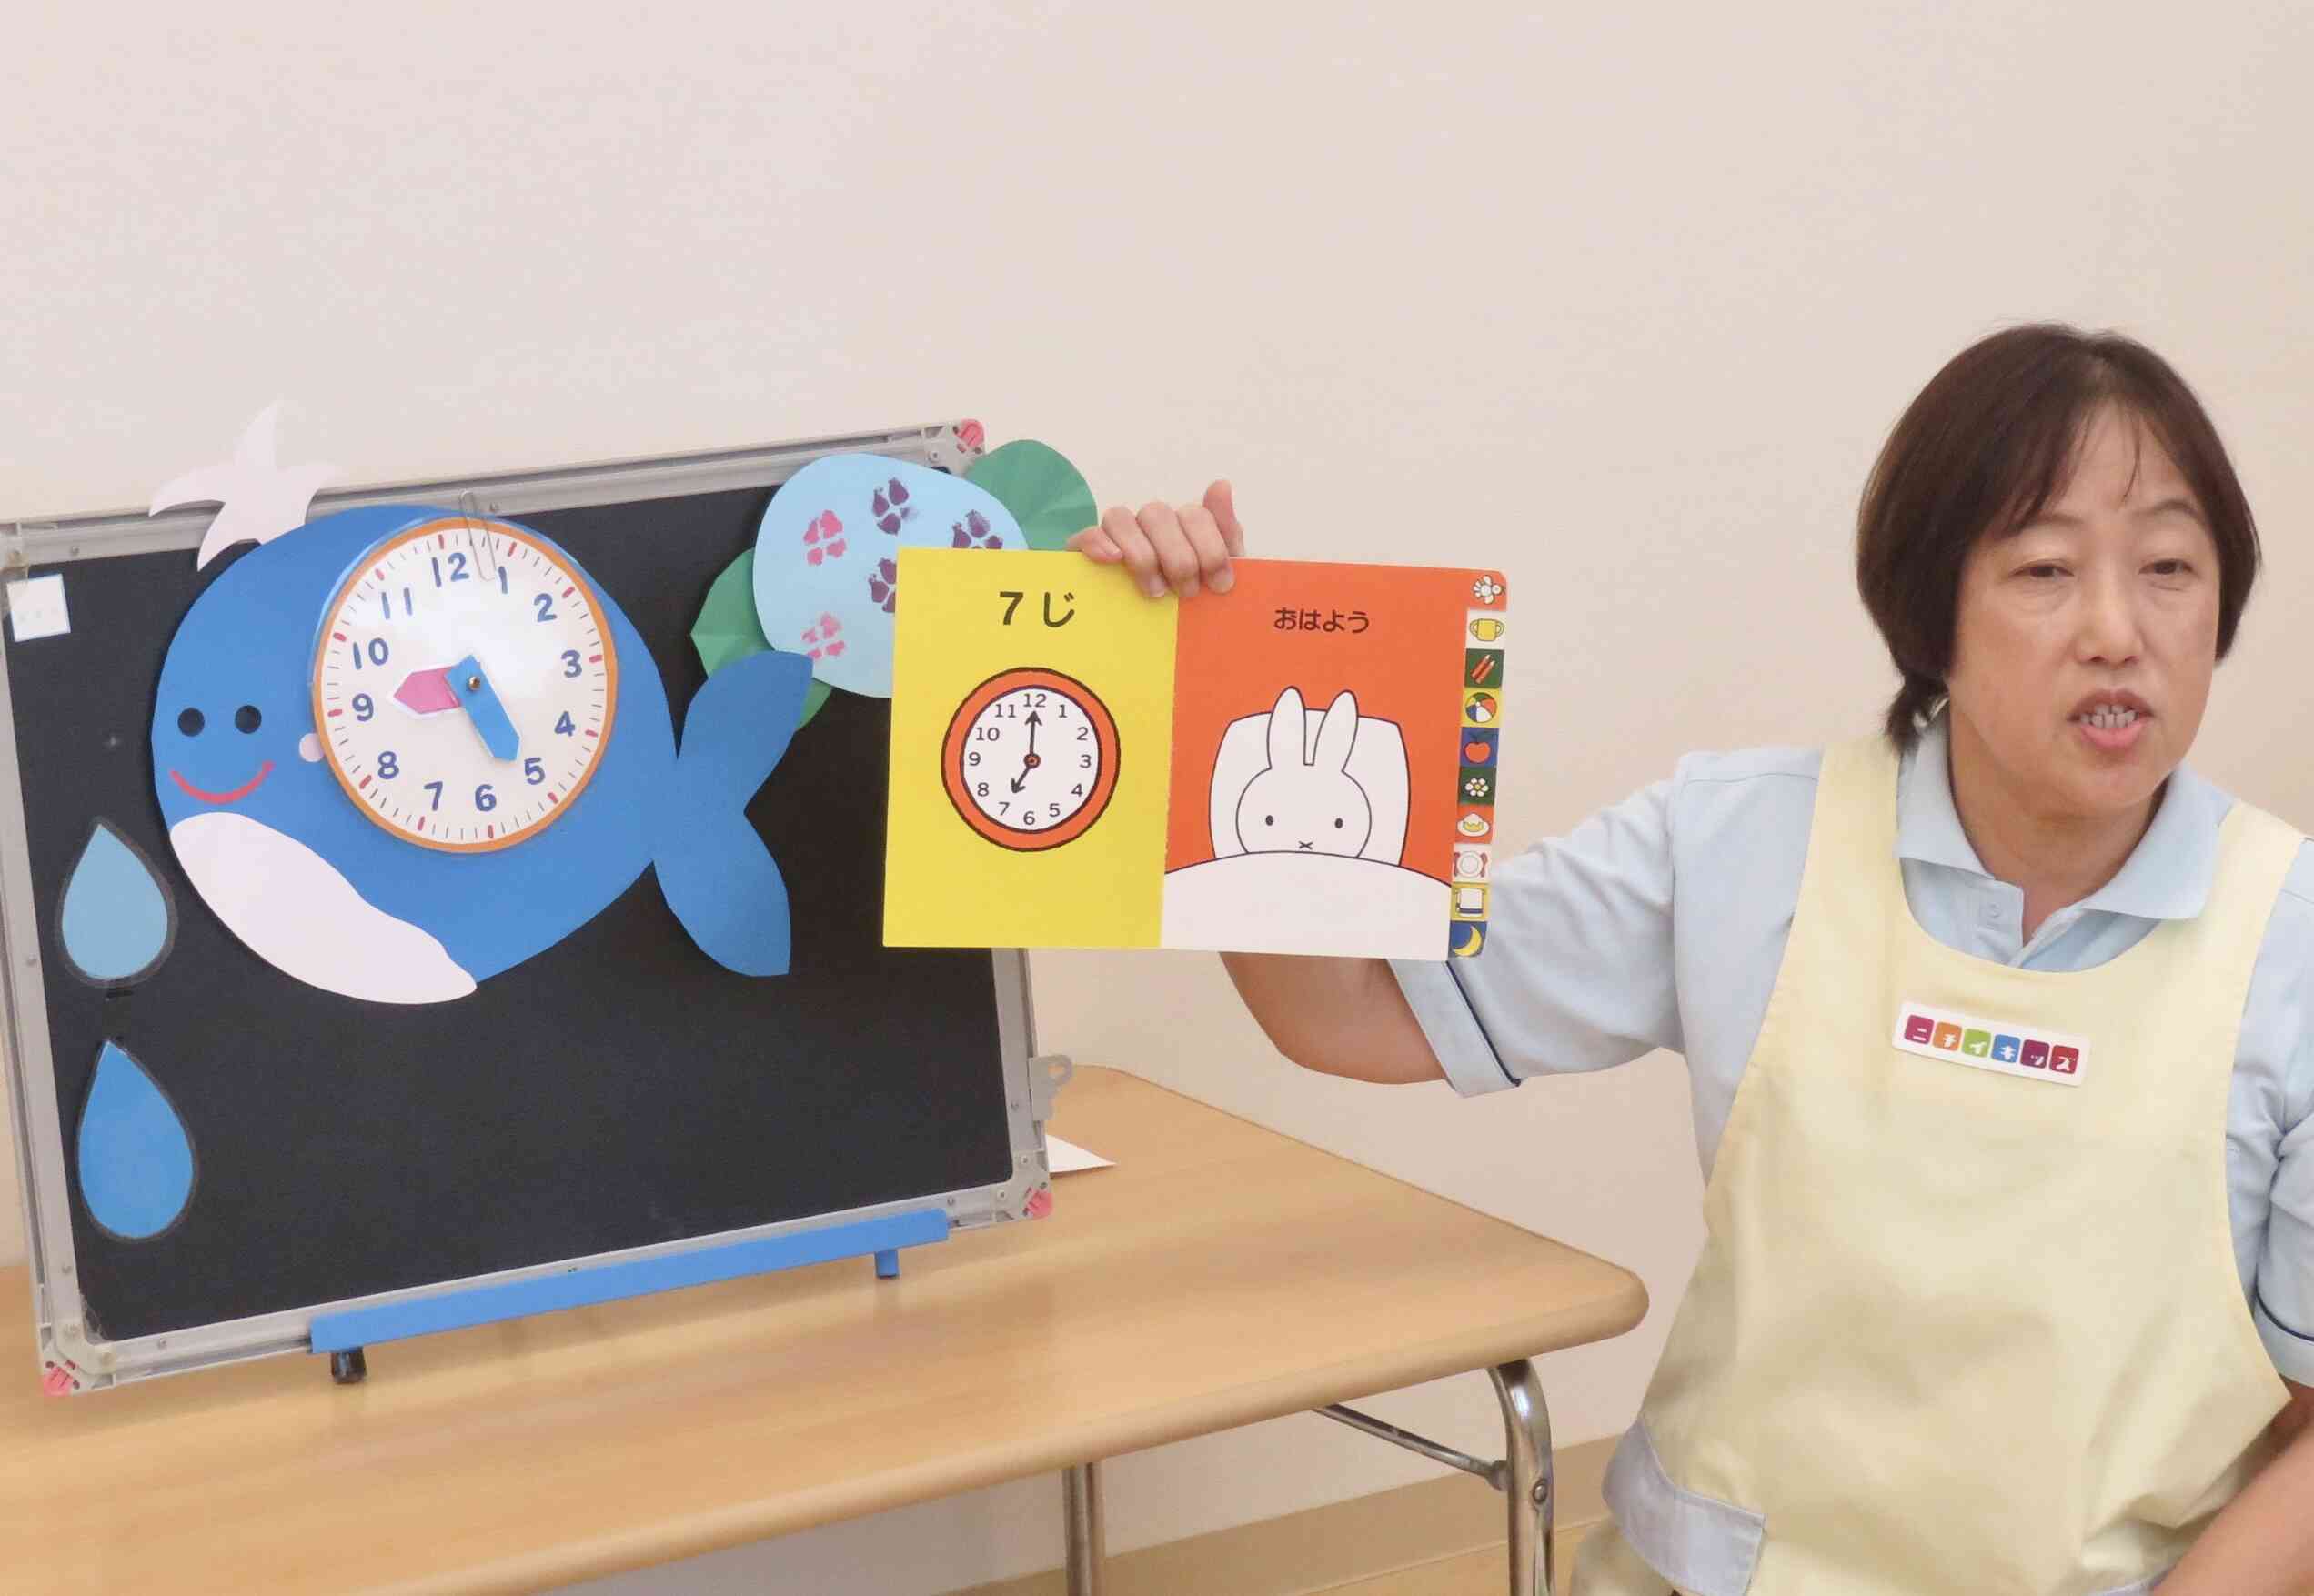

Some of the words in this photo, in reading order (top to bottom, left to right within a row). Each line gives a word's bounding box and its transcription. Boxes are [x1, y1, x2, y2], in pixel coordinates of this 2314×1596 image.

[431, 552, 470, 587] 12
[498, 566, 508, 594] 1
[381, 587, 413, 619] 11
[533, 593, 557, 622] 2
[1273, 607, 1370, 635] おはよう
[353, 637, 389, 670] 10
[561, 649, 582, 678] 3
[352, 693, 374, 721] 9
[995, 704, 1016, 718] 11
[1023, 693, 1046, 708] 12
[1058, 704, 1068, 718] 1
[554, 711, 576, 737] 4
[975, 727, 1000, 741] 10
[1077, 727, 1088, 740] 2
[377, 751, 399, 779] 8
[524, 757, 545, 785] 5
[968, 752, 981, 766] 9
[1080, 754, 1092, 768] 3
[424, 781, 444, 811] 7
[474, 784, 497, 811] 6
[977, 782, 990, 797] 8
[1071, 783, 1082, 797] 4
[999, 802, 1010, 816] 7
[1023, 811, 1035, 825] 6
[1049, 803, 1061, 817] 5
